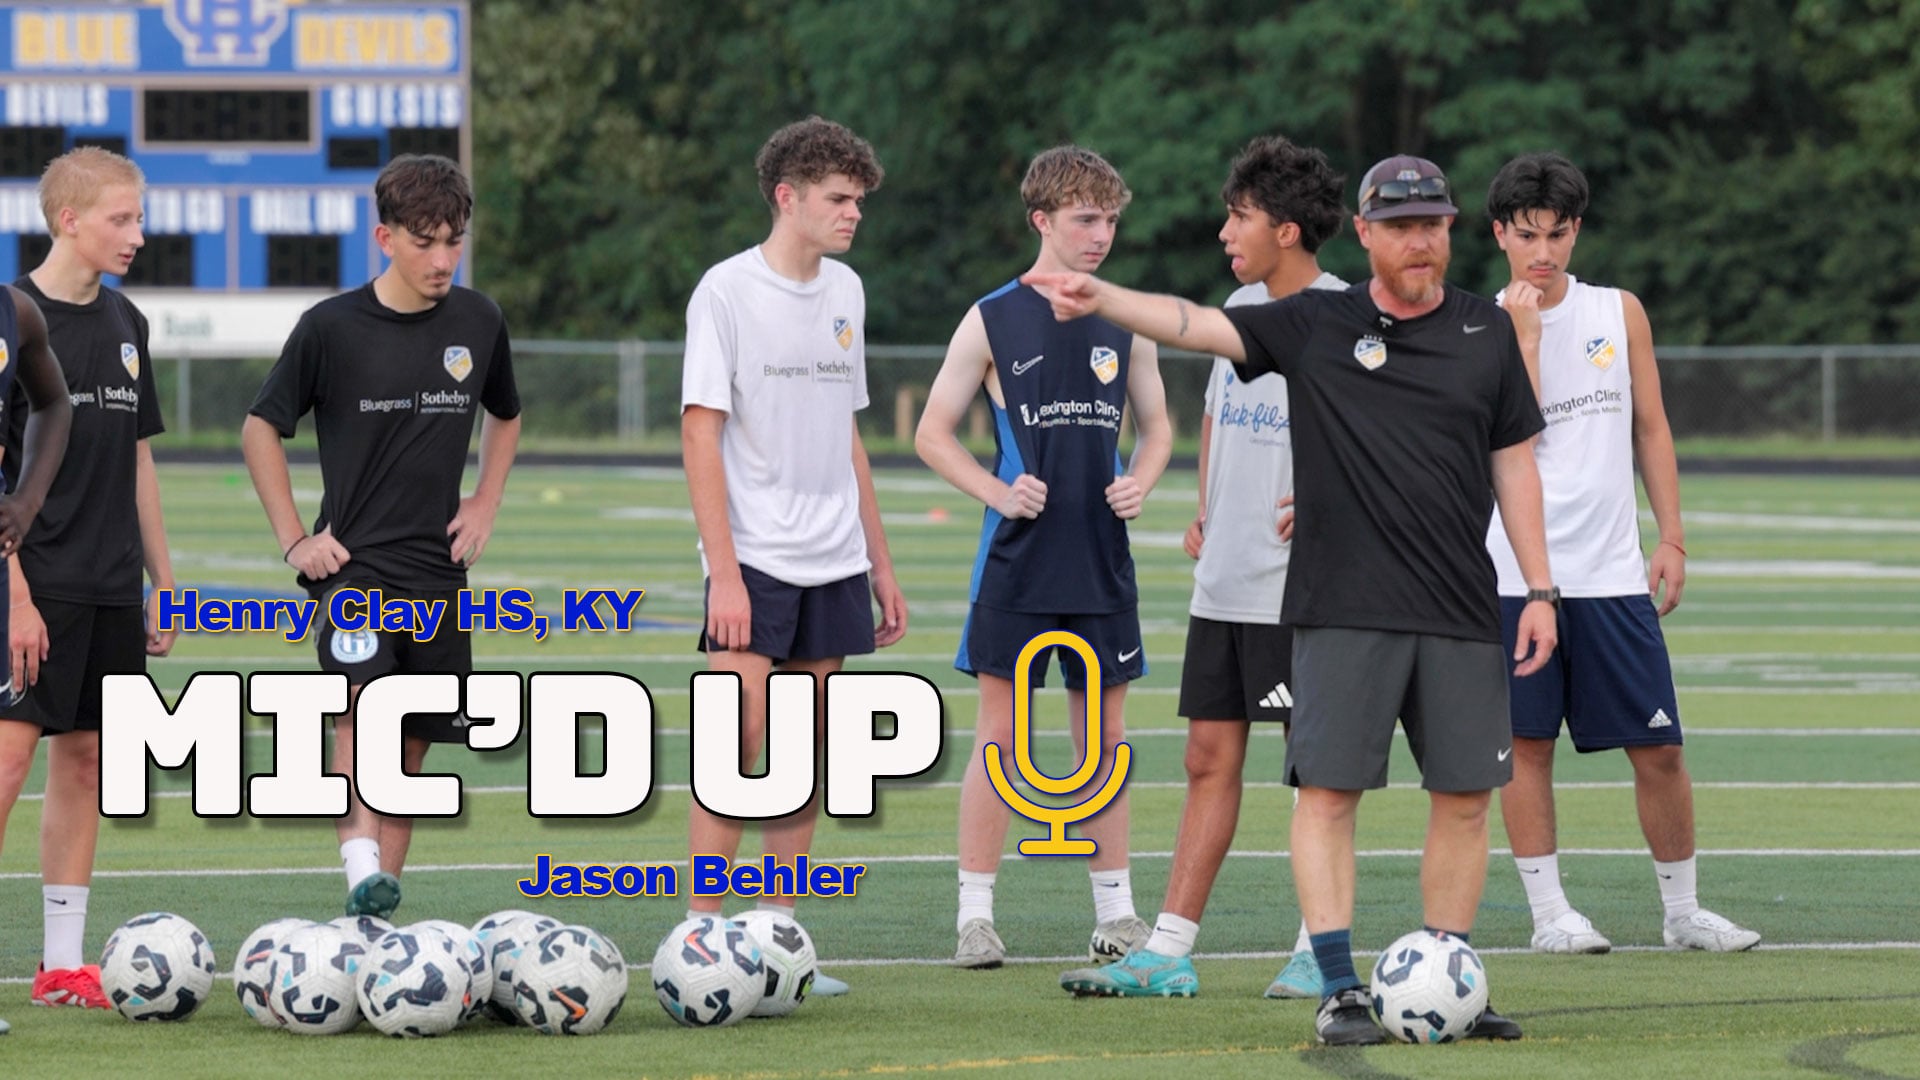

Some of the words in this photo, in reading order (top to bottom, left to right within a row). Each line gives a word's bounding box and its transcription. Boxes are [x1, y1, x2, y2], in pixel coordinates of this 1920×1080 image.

[14, 10, 137, 69] BLUE
[295, 11, 456, 69] DEVILS
[331, 84, 460, 126] GUESTS
[763, 364, 809, 378] Bluegrass
[360, 399, 412, 413] Bluegrass
[1540, 394, 1593, 416] exington
